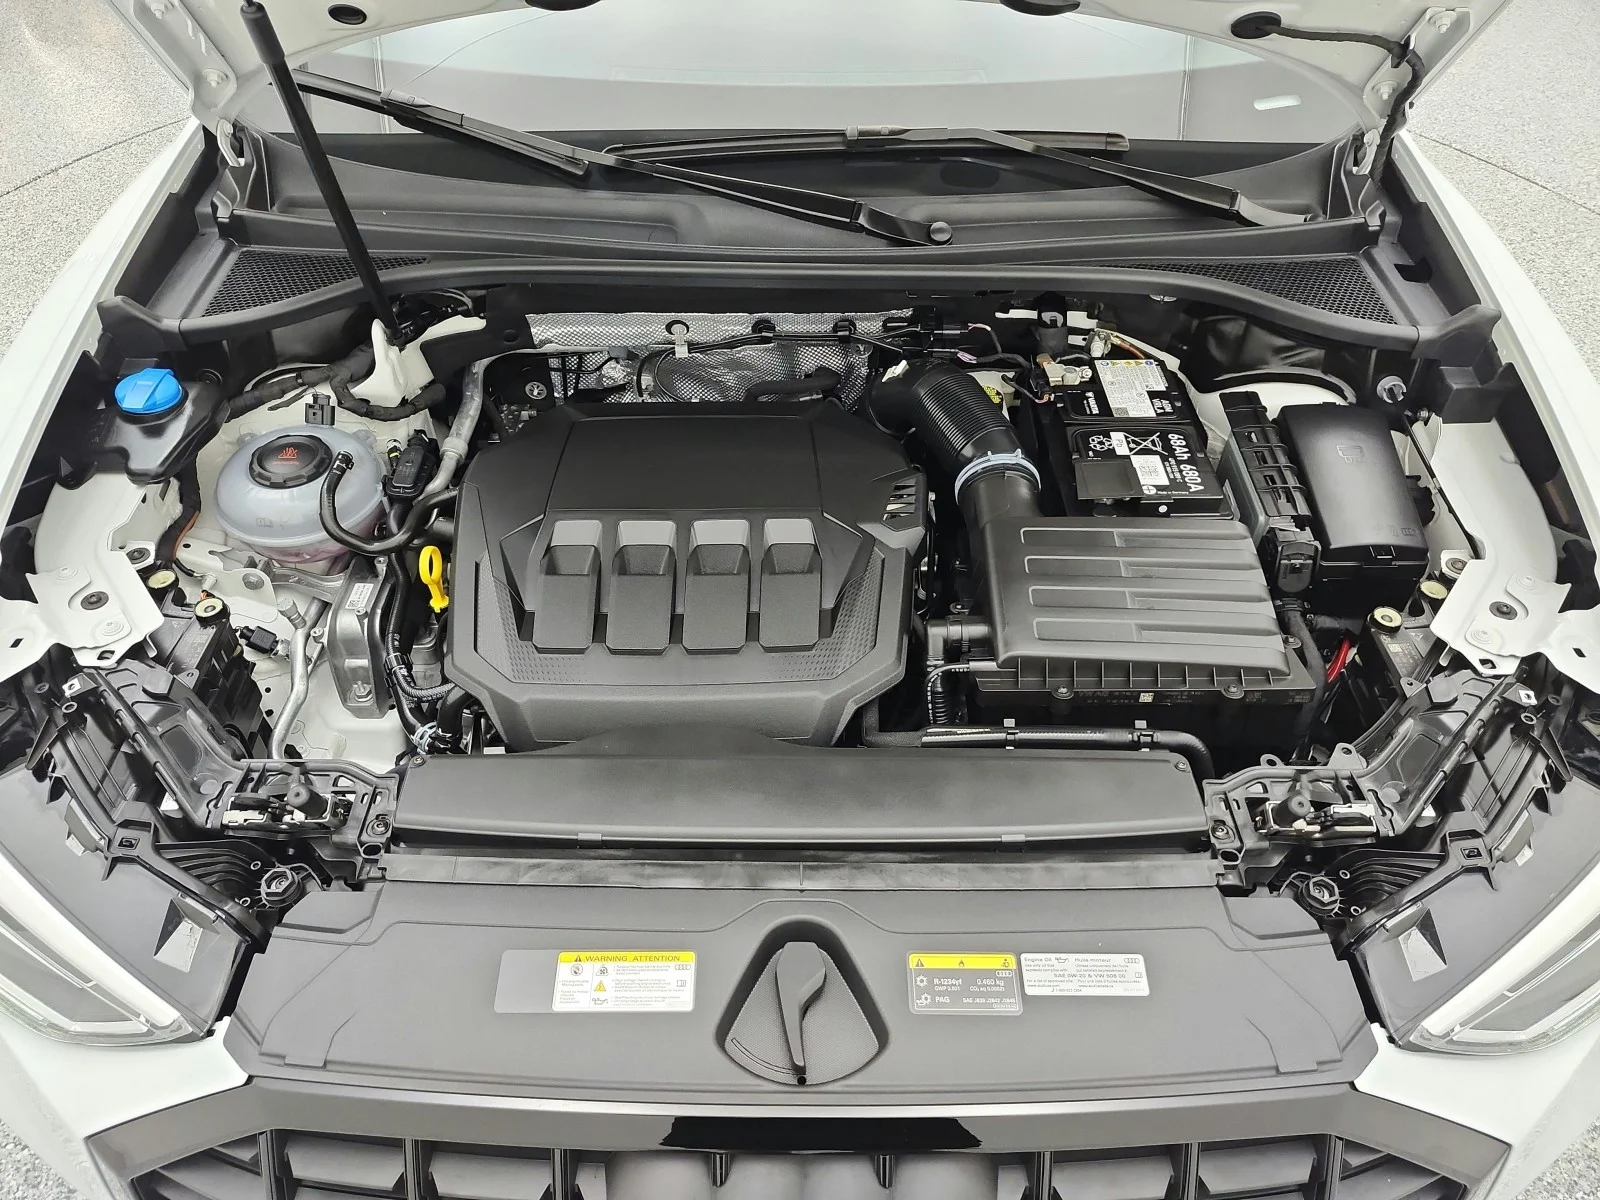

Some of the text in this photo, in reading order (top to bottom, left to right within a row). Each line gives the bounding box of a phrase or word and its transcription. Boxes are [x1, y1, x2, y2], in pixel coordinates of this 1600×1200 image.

[1116, 438, 1123, 448] Pb
[1168, 433, 1192, 460] 68Ah
[1179, 464, 1205, 492] 680A
